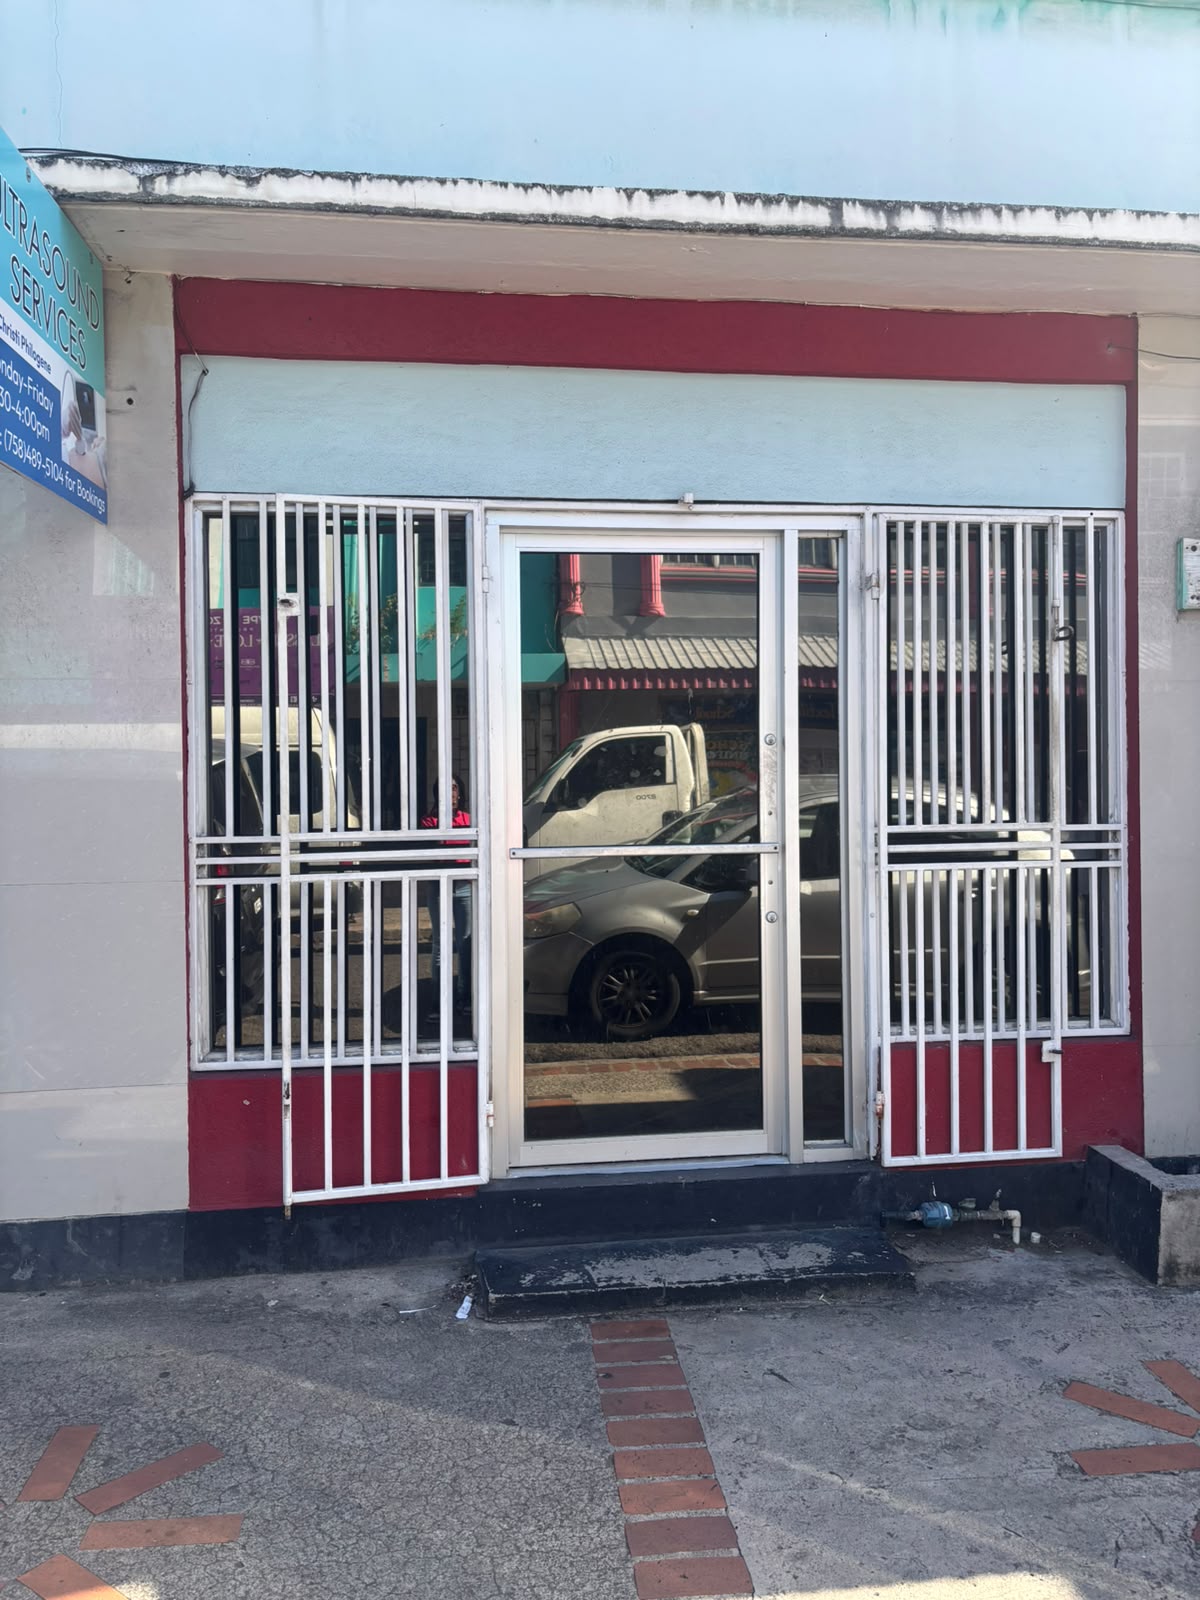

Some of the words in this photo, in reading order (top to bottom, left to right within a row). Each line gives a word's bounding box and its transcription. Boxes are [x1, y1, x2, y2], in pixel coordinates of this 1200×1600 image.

[0, 173, 100, 331] LTRASOUND
[10, 254, 87, 370] SERVICES
[21, 335, 52, 375] Philogene
[0, 359, 54, 418] nday-Friday
[4, 428, 64, 486] (758)489-5104
[65, 471, 76, 492] for
[77, 479, 105, 515] Bookings
